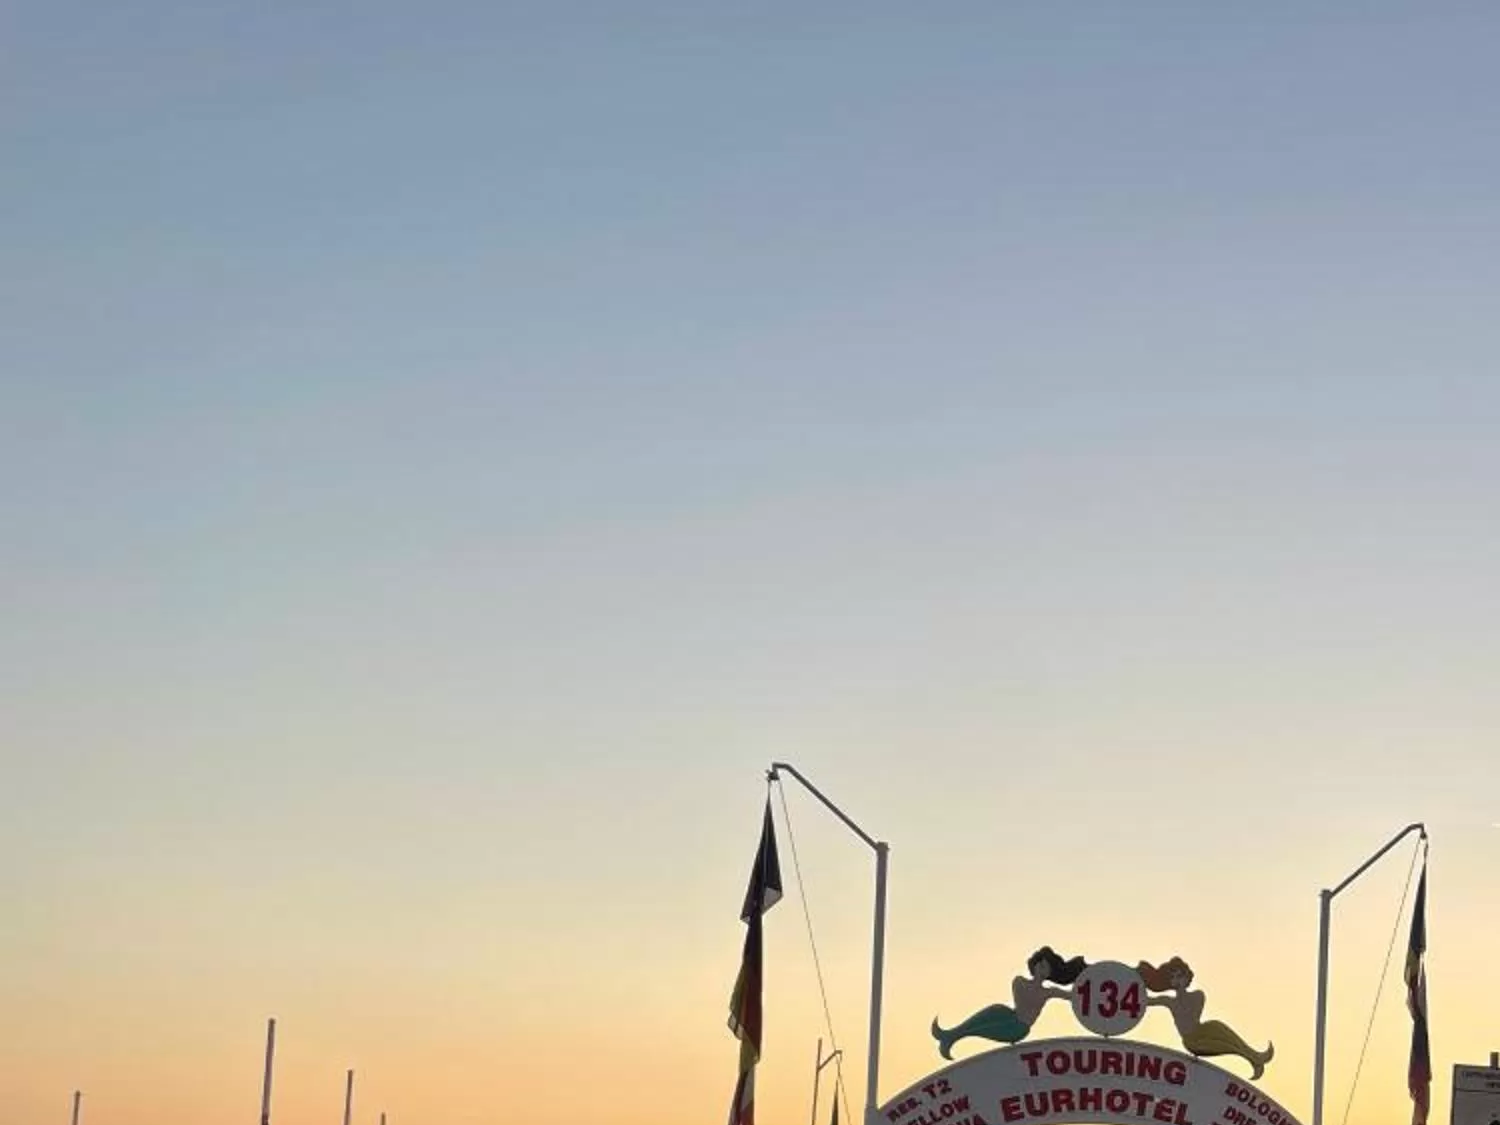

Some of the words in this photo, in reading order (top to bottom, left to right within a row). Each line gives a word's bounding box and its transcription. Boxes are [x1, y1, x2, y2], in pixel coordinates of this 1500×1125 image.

[1077, 980, 1141, 1019] 134
[1020, 1049, 1187, 1086] TOURING
[921, 1078, 952, 1100] T2
